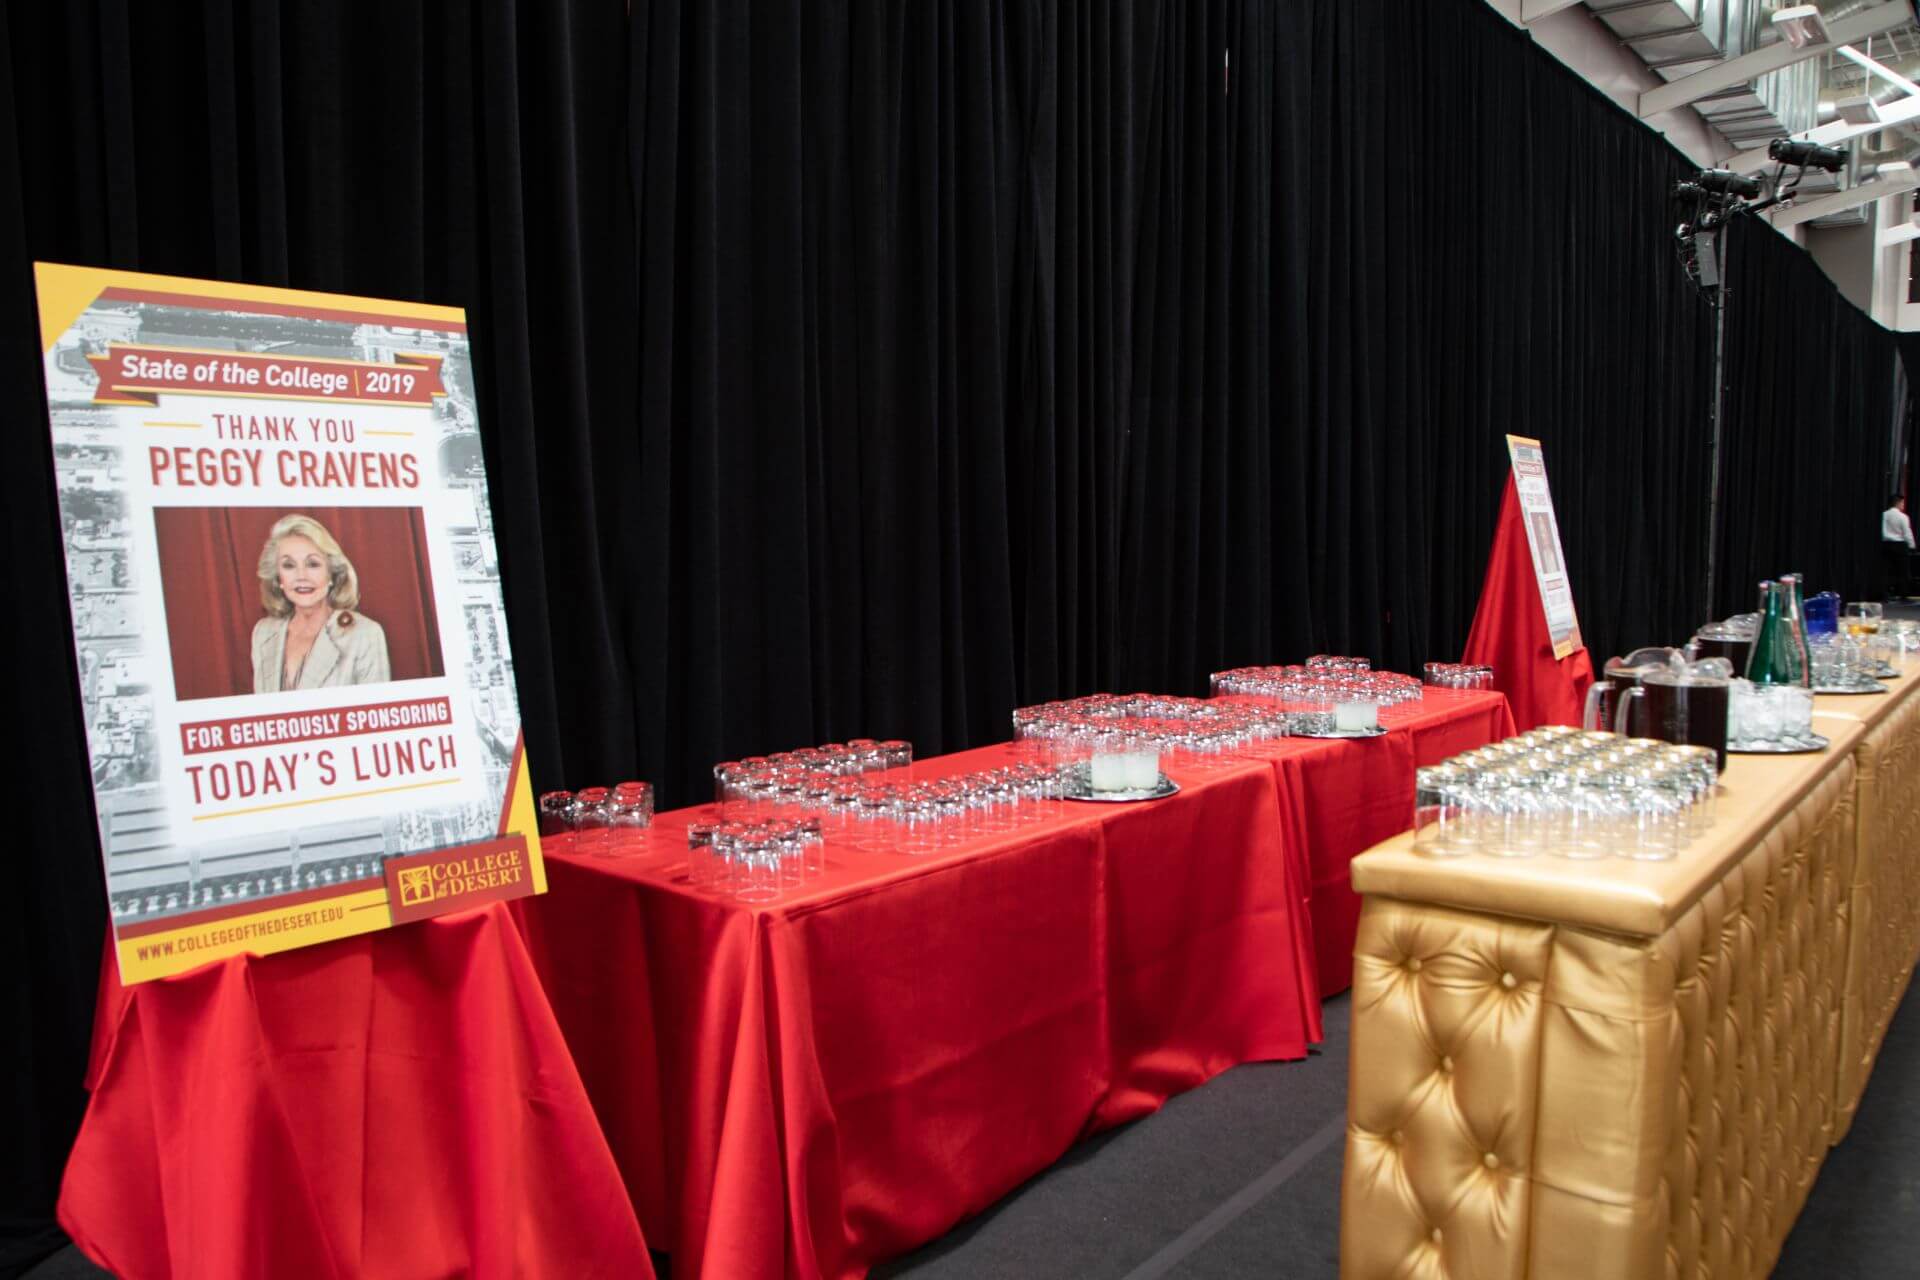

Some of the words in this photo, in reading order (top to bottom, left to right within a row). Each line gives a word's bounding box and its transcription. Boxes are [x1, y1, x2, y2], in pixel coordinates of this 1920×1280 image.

[121, 355, 187, 380] State
[193, 359, 218, 383] of
[222, 362, 260, 385] the
[265, 365, 349, 393] College
[366, 372, 415, 394] 2019
[212, 413, 298, 441] THANK
[309, 418, 355, 444] YOU
[148, 446, 262, 487] PEGGY
[277, 450, 420, 489] CRAVENS
[185, 724, 224, 751] FOR
[230, 713, 341, 745] GENEROUSLY
[347, 701, 448, 732] SPONSORING
[185, 750, 337, 804] TODAY'S
[352, 734, 458, 781] LUNCH
[432, 850, 521, 881] COLLEGE
[450, 866, 522, 896] DESERT
[136, 906, 344, 961] WWW.COLLEGEOFTHEDESERT.EDU
